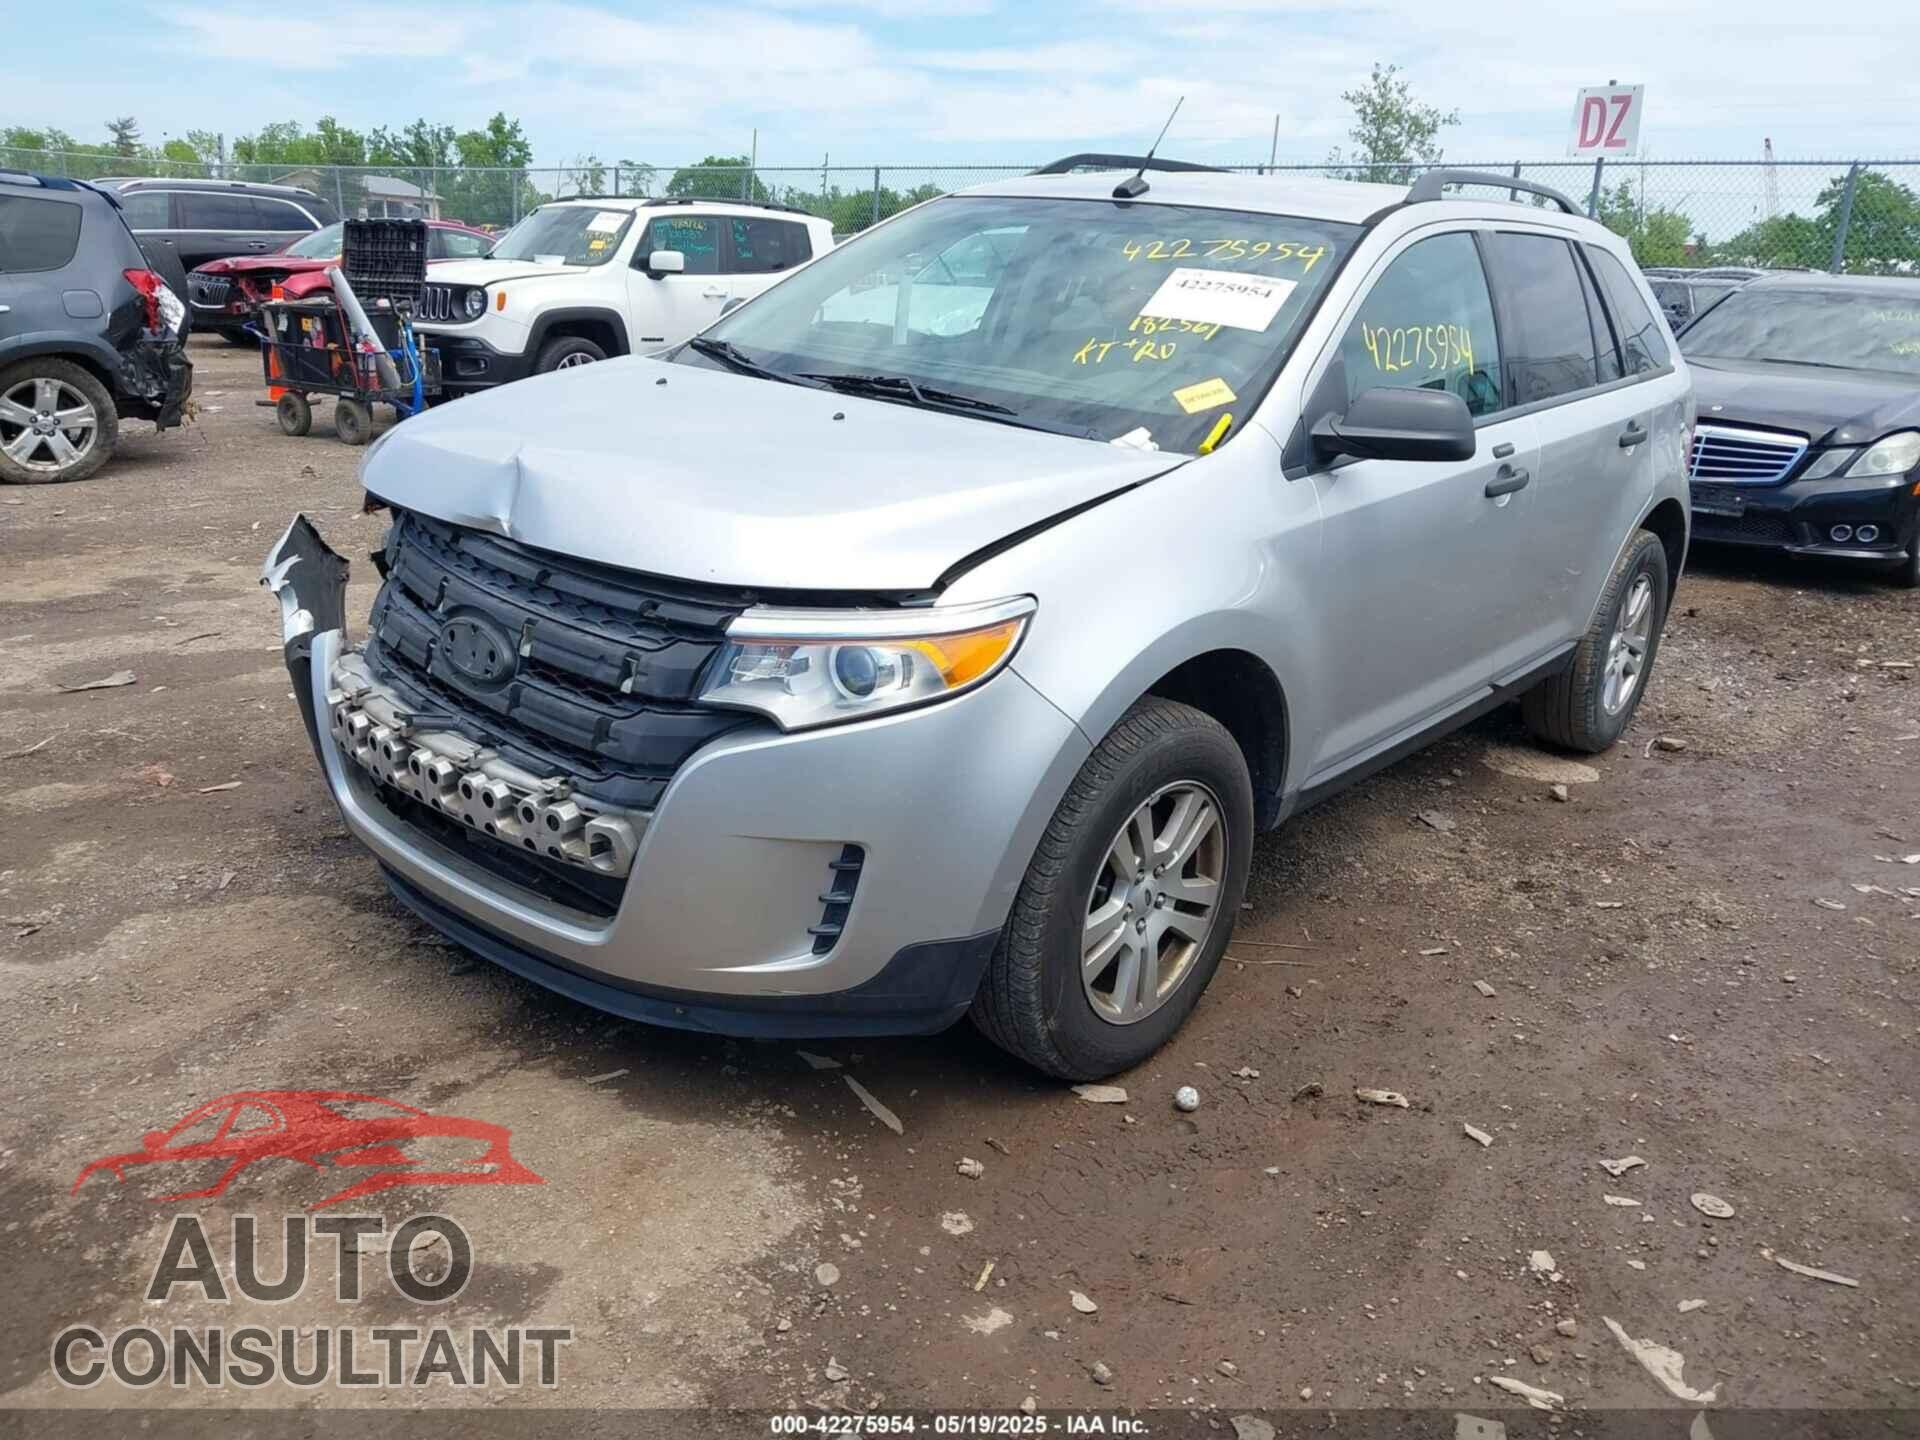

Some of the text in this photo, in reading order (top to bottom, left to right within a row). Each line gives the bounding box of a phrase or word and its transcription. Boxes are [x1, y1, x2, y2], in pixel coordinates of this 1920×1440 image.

[1578, 94, 1633, 148] DZ
[1123, 239, 1325, 274] 42275954
[1176, 279, 1273, 299] 42275954
[1362, 321, 1474, 376] 42275954
